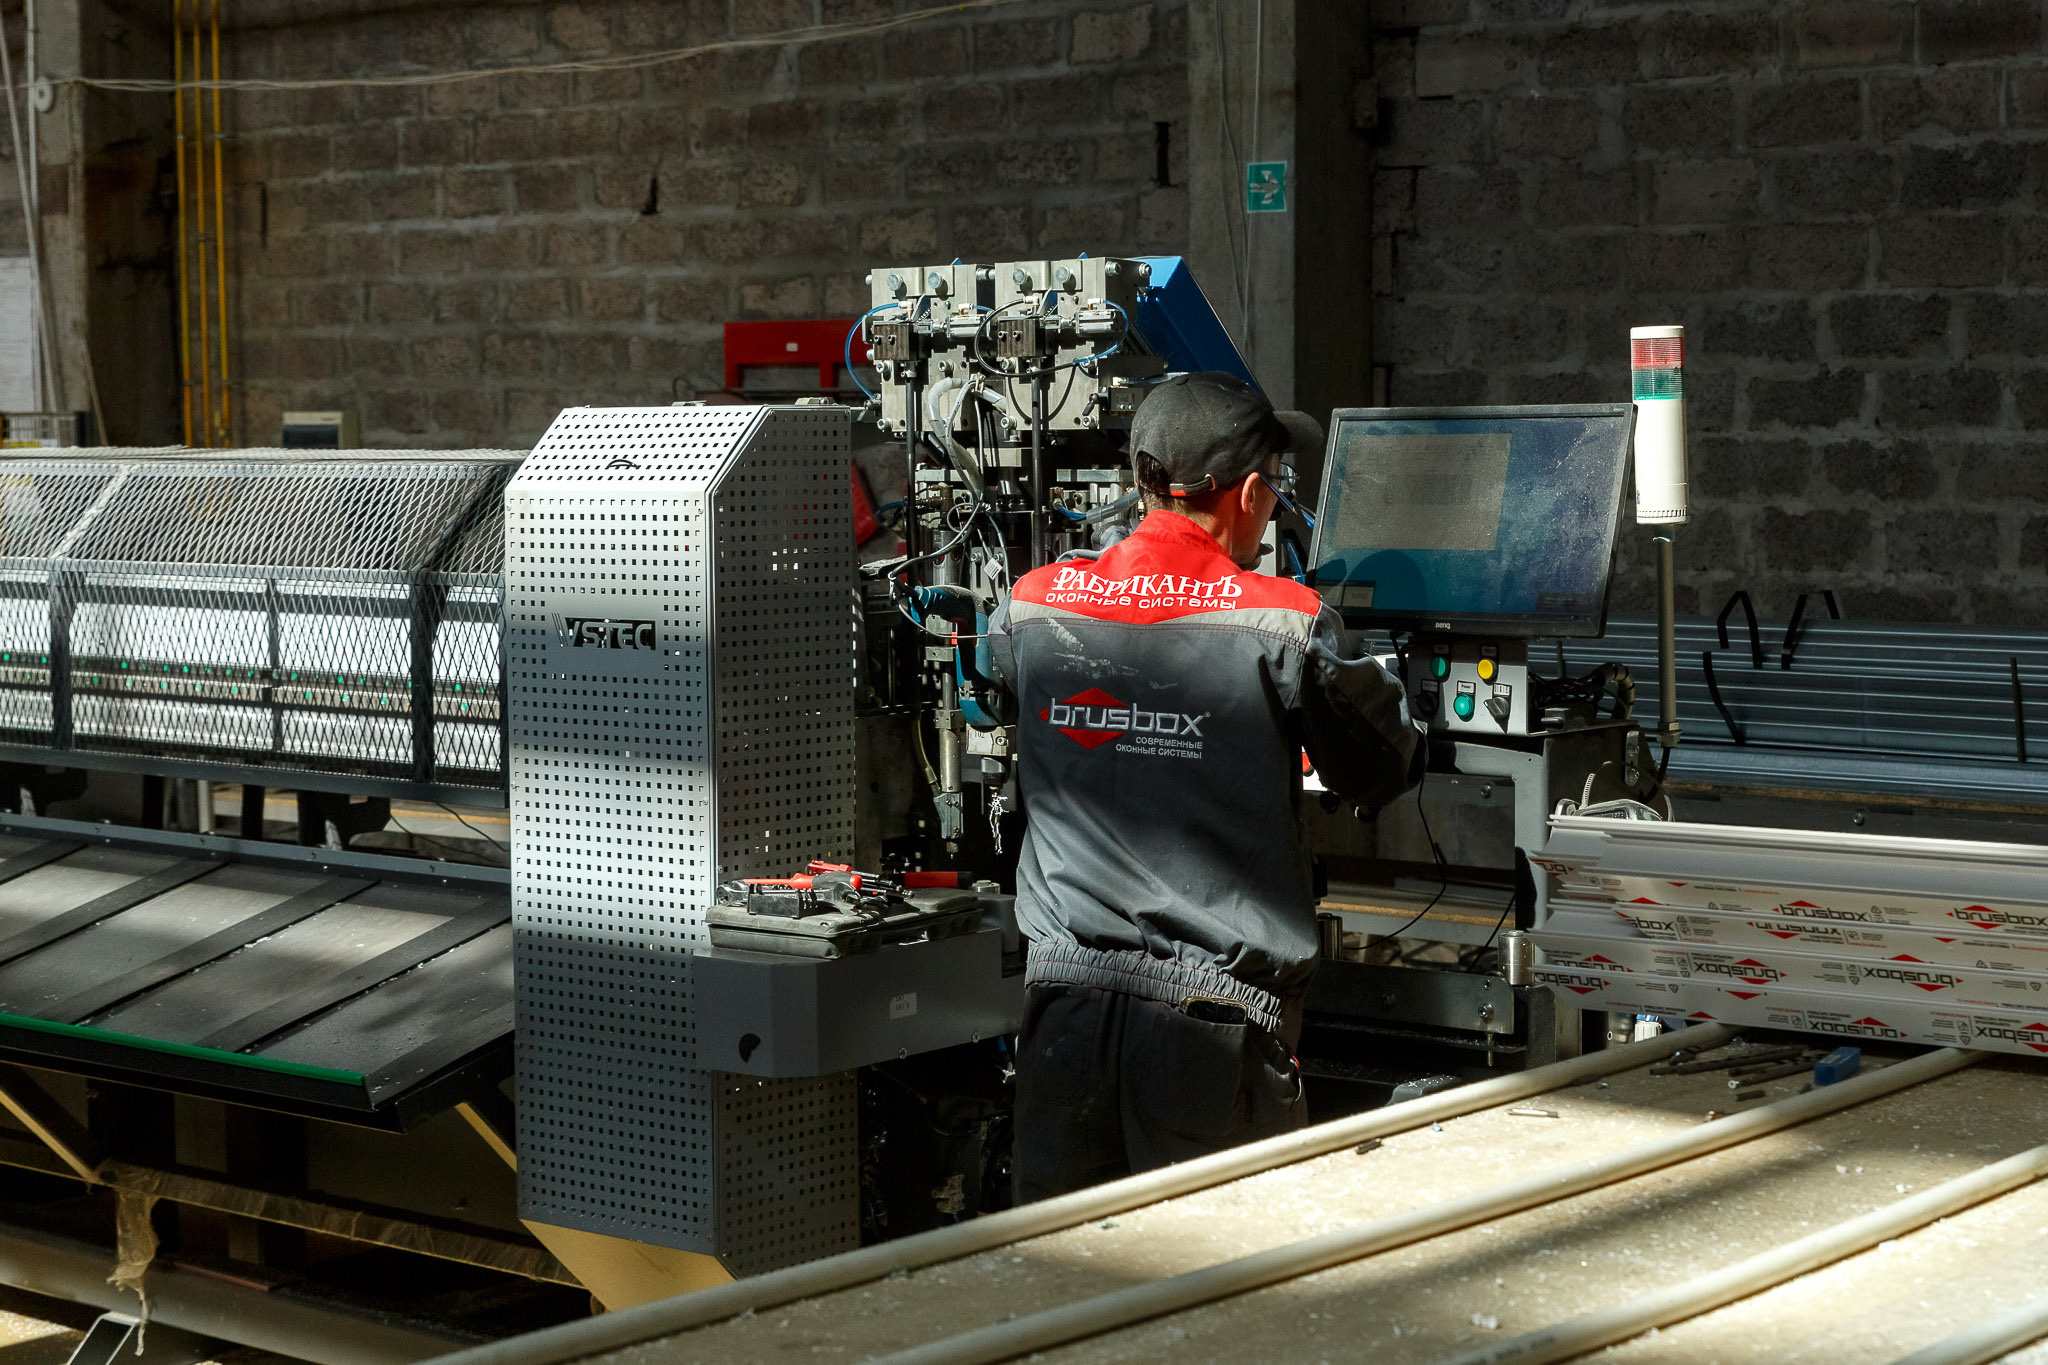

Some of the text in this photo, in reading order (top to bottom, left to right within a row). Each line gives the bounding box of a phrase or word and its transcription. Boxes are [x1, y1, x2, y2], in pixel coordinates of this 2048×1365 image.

[1052, 567, 1242, 597] ФАБРИКАНТЪ
[1115, 743, 1202, 759] ОКОННЫЕ СИСТЕМЫ
[1136, 737, 1203, 749] СОВРЕМЕННЫЕ
[1779, 904, 1869, 922] brusbox
[1953, 908, 2048, 926] brusbox
[1694, 962, 1780, 982] brusbox
[1864, 967, 1955, 988] brusbox
